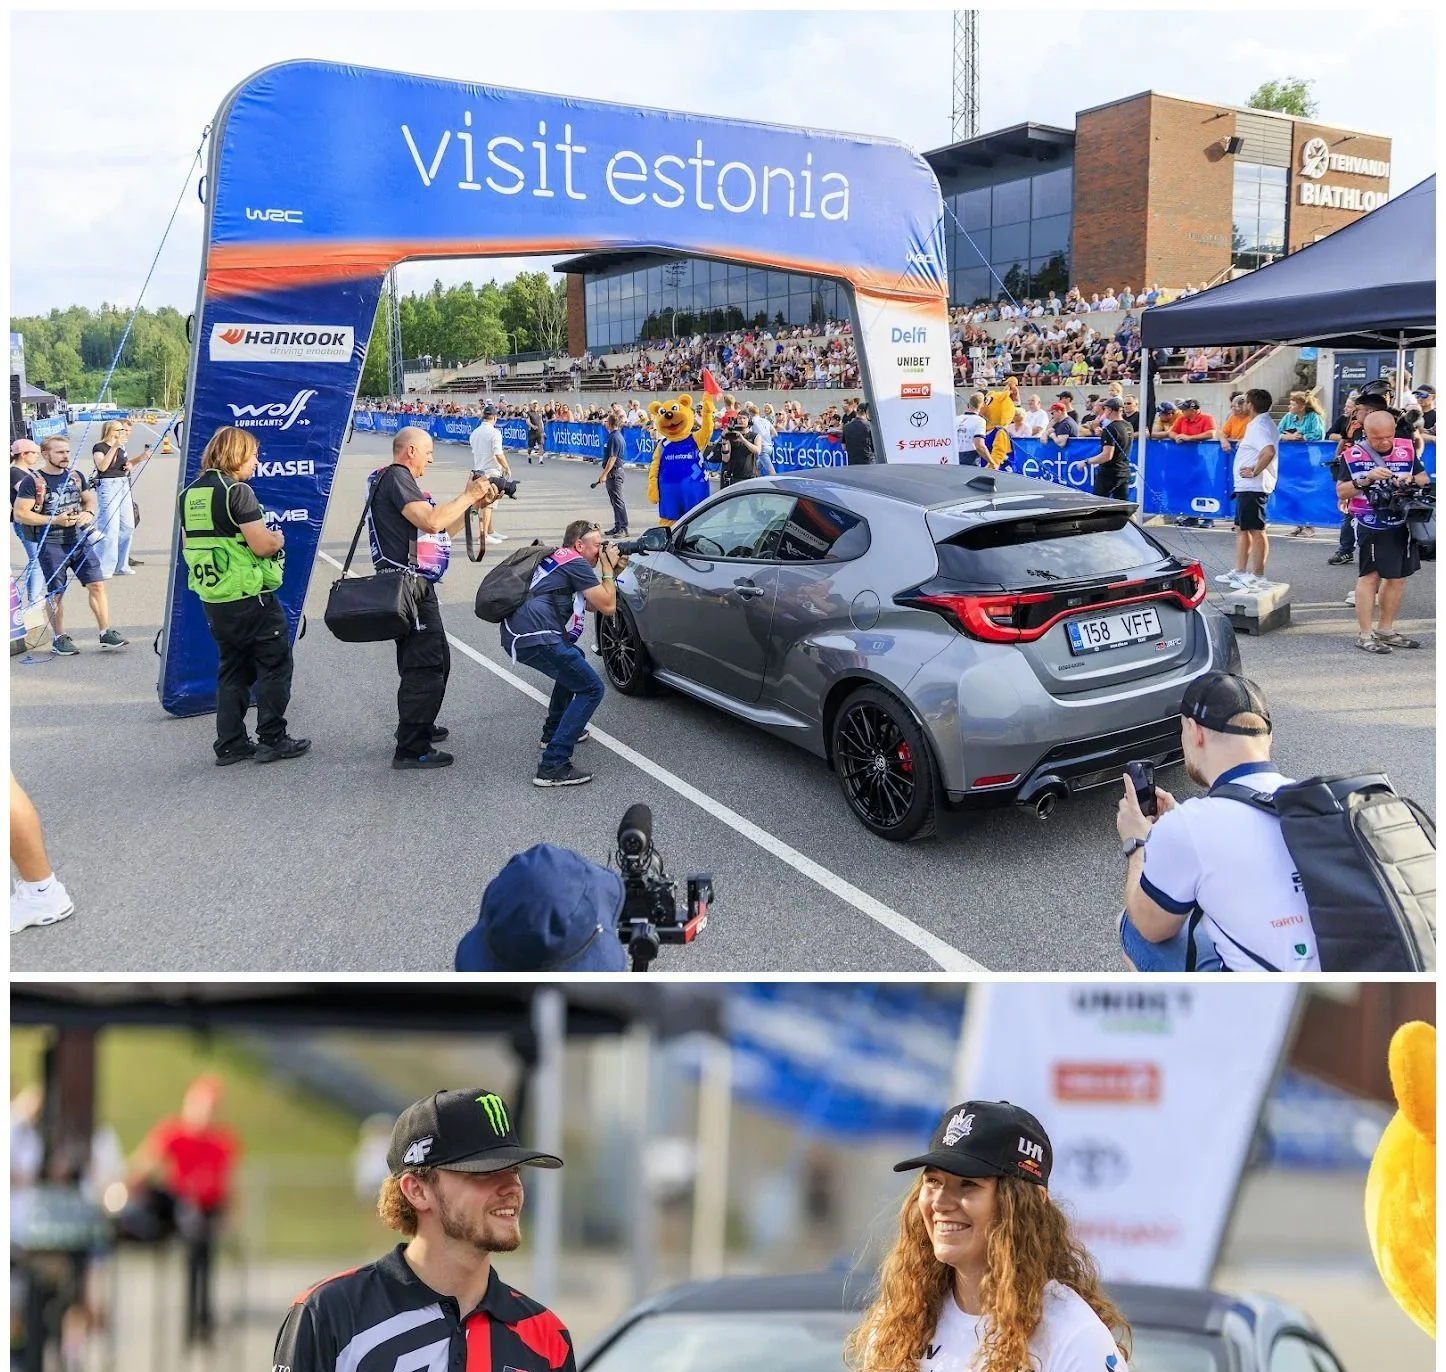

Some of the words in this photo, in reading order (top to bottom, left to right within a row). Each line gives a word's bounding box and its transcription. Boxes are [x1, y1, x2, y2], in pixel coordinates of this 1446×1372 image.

[401, 110, 587, 200] visit
[605, 139, 850, 222] estonia
[1329, 153, 1390, 178] TEHVANDI
[1301, 182, 1389, 212] BIATHLON
[245, 207, 304, 223] WRC
[891, 327, 927, 344] Delfi
[270, 346, 302, 357] driving
[306, 347, 345, 356] emotion
[897, 356, 931, 367] UNIBET
[235, 418, 284, 428] LUBRICANTS
[553, 428, 571, 444] visit
[571, 430, 600, 447] estonia
[909, 437, 951, 449] SPORTLAND
[771, 441, 795, 466] isit
[193, 563, 220, 588] 95
[1083, 621, 1111, 645] 158
[1120, 612, 1152, 636] VFF
